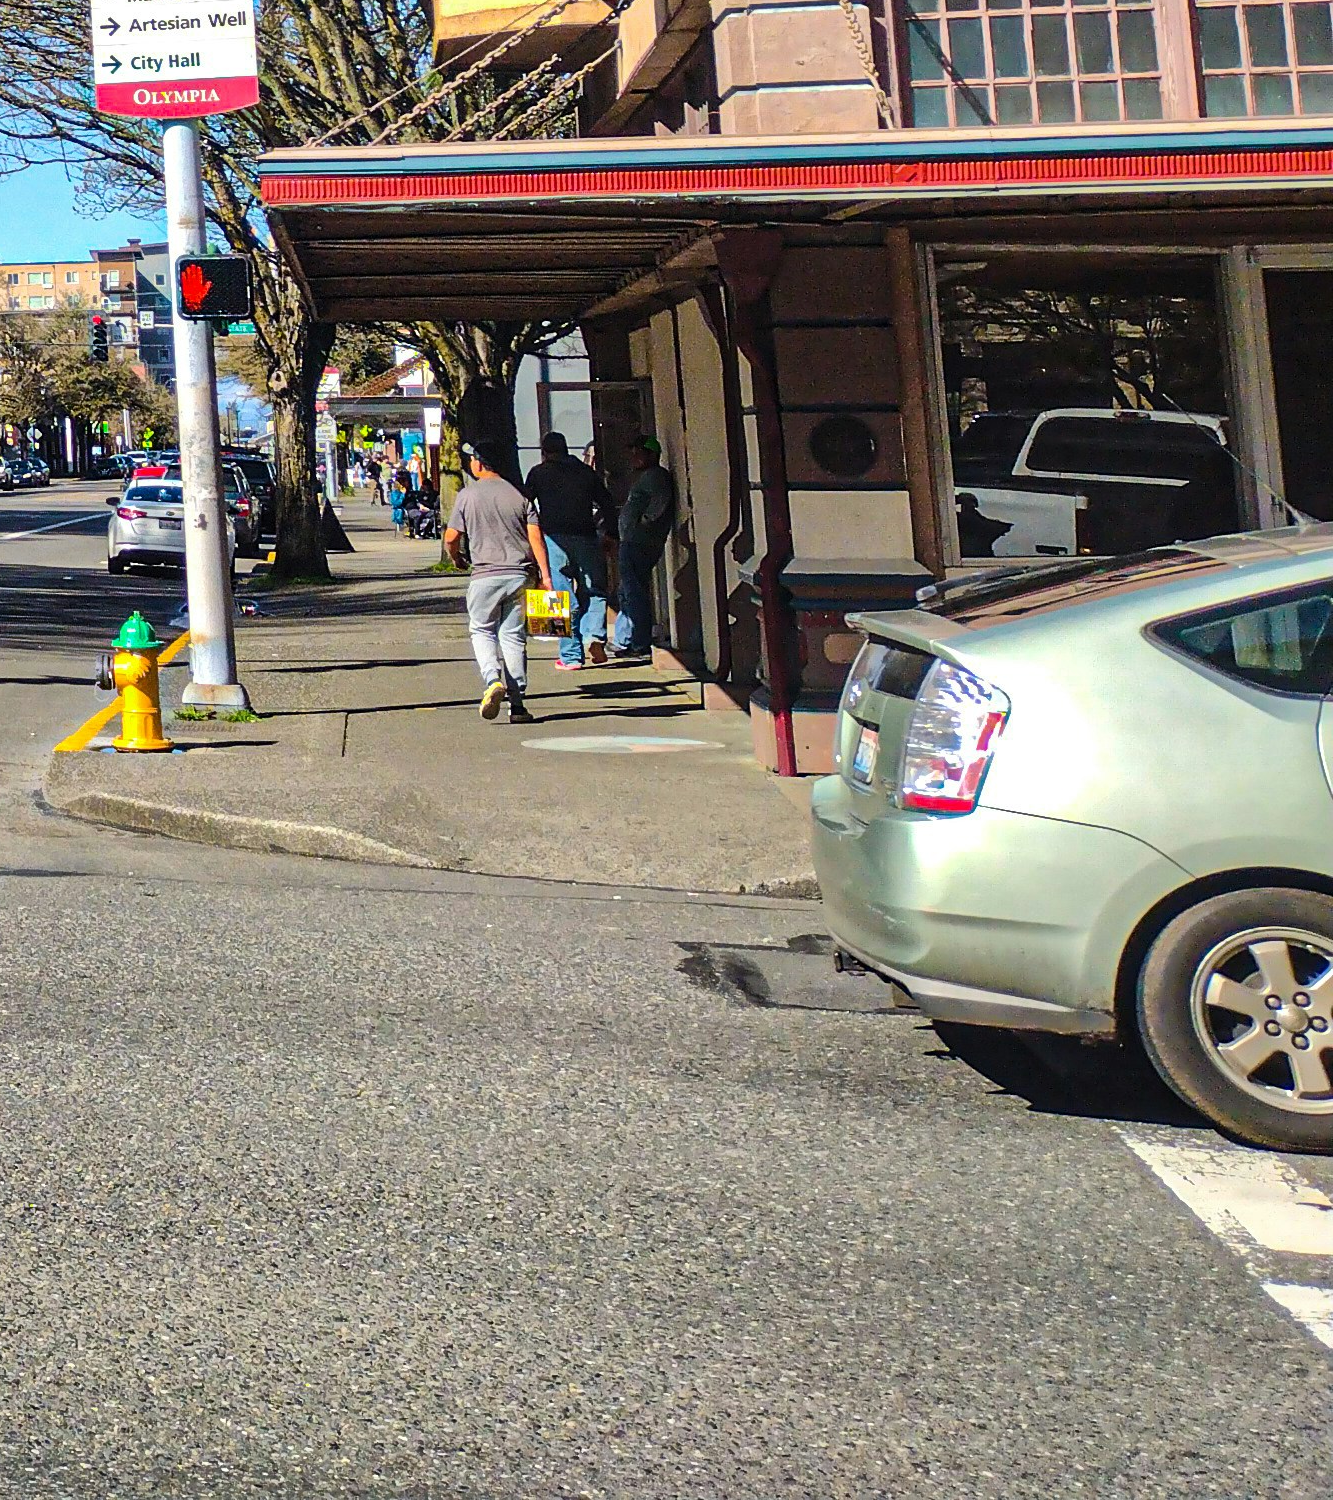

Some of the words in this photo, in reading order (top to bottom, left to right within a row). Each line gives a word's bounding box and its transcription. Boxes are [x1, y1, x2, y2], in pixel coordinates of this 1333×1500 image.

[129, 15, 201, 33] Artesian
[208, 10, 247, 28] Well
[131, 55, 163, 73] City
[169, 52, 201, 68] Hall
